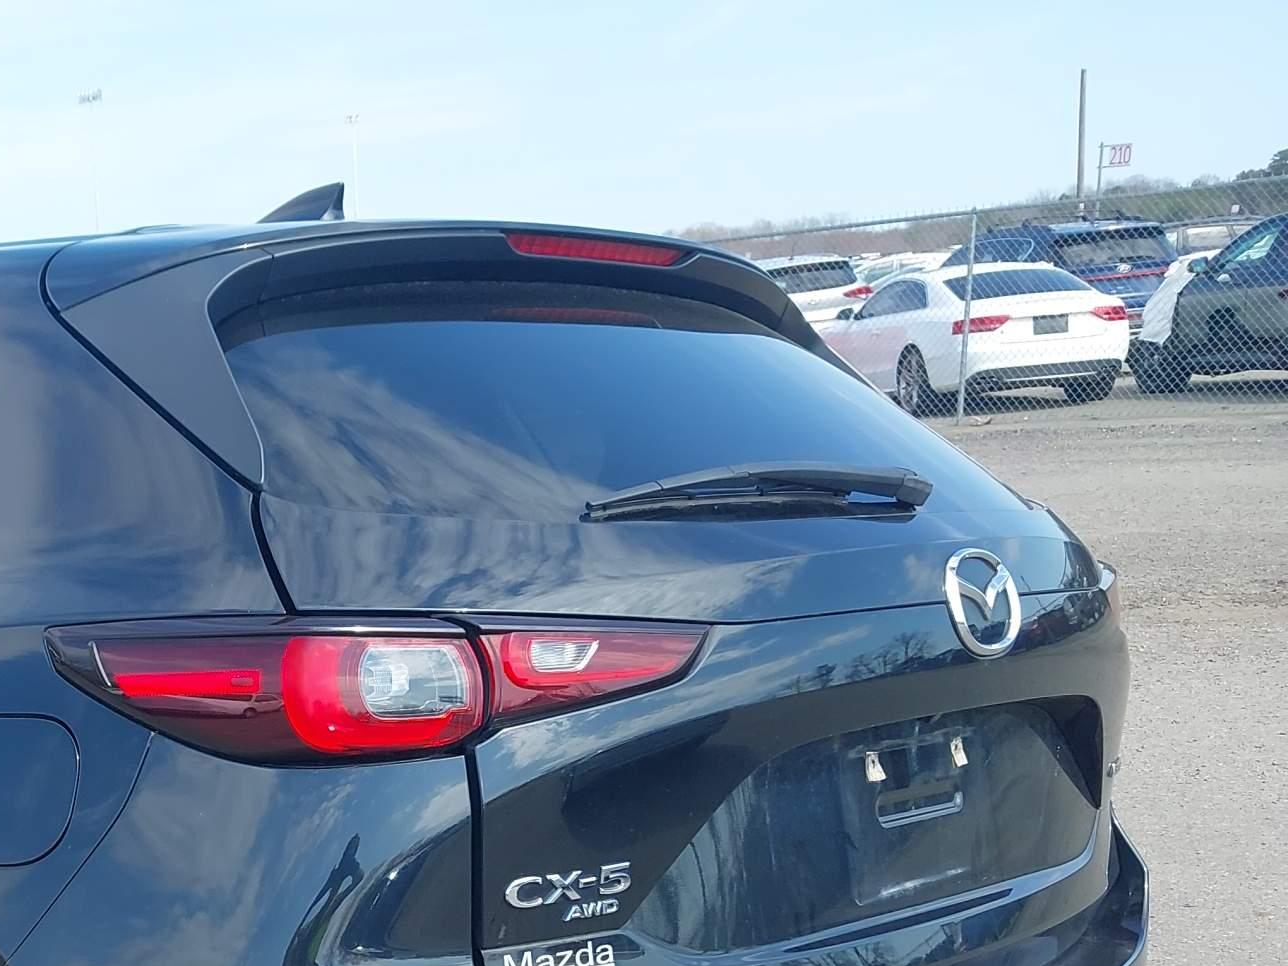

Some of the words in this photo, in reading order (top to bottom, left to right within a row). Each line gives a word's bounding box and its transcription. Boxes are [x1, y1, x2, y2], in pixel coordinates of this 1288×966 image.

[1109, 145, 1132, 165] 210
[505, 861, 631, 908] CX-5
[562, 899, 620, 921] AWD
